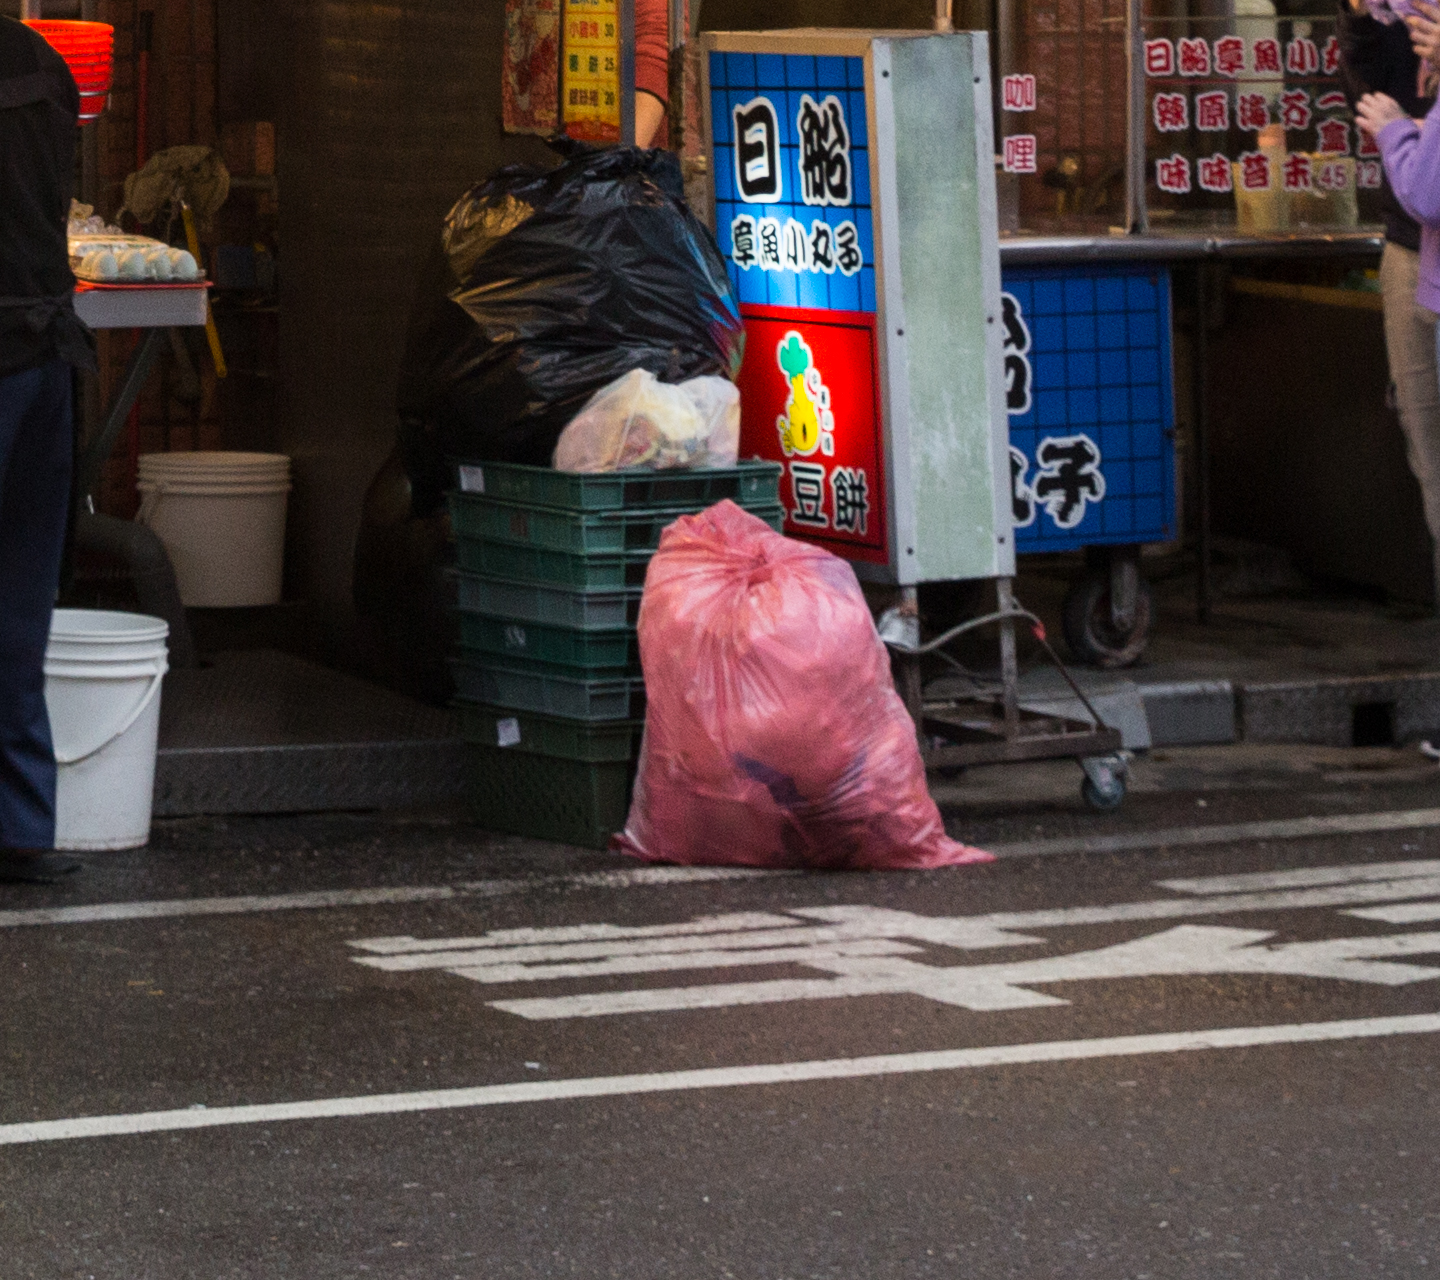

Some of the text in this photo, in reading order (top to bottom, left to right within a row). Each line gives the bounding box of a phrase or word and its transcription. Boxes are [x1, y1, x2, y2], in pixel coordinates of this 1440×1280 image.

[1003, 74, 1036, 173] 咖哩
[730, 214, 862, 276] 章魚小丸子
